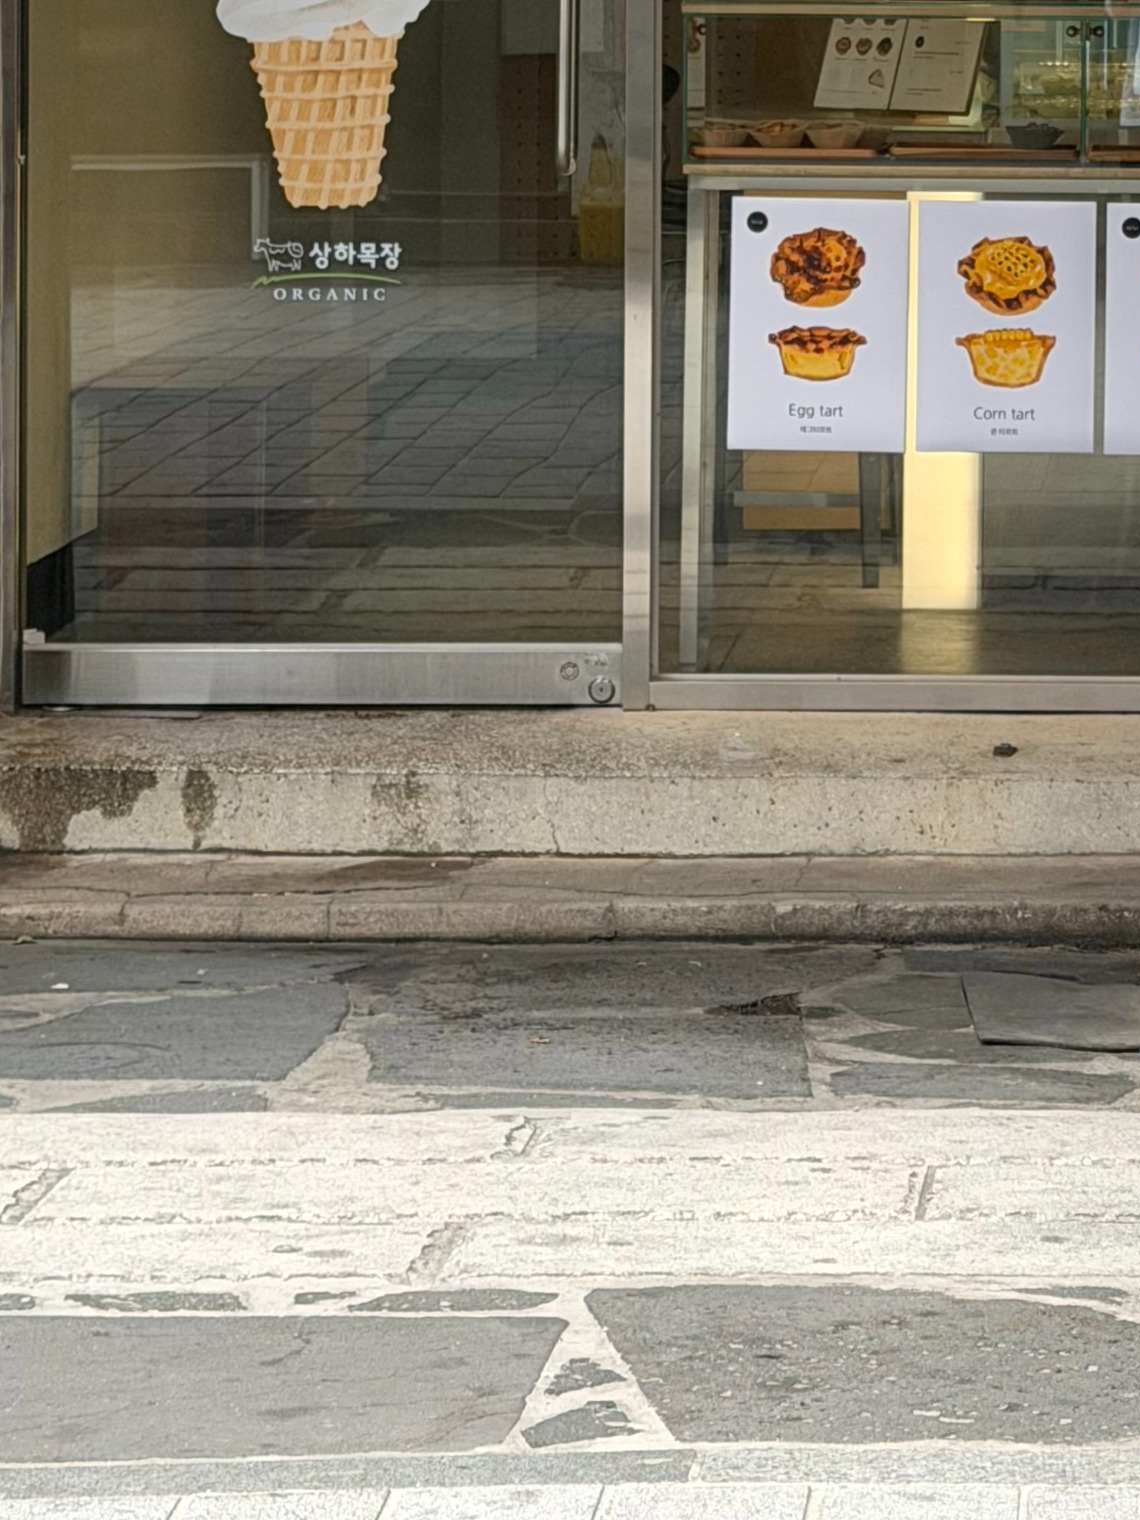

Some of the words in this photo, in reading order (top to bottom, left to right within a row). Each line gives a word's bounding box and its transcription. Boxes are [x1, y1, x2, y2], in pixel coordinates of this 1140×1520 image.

[308, 242, 403, 270] 상하목장
[273, 287, 388, 301] ORGANIC
[788, 403, 815, 419] Egg
[819, 404, 844, 418] tart
[973, 406, 1007, 421] Corn
[1011, 408, 1036, 421] tart
